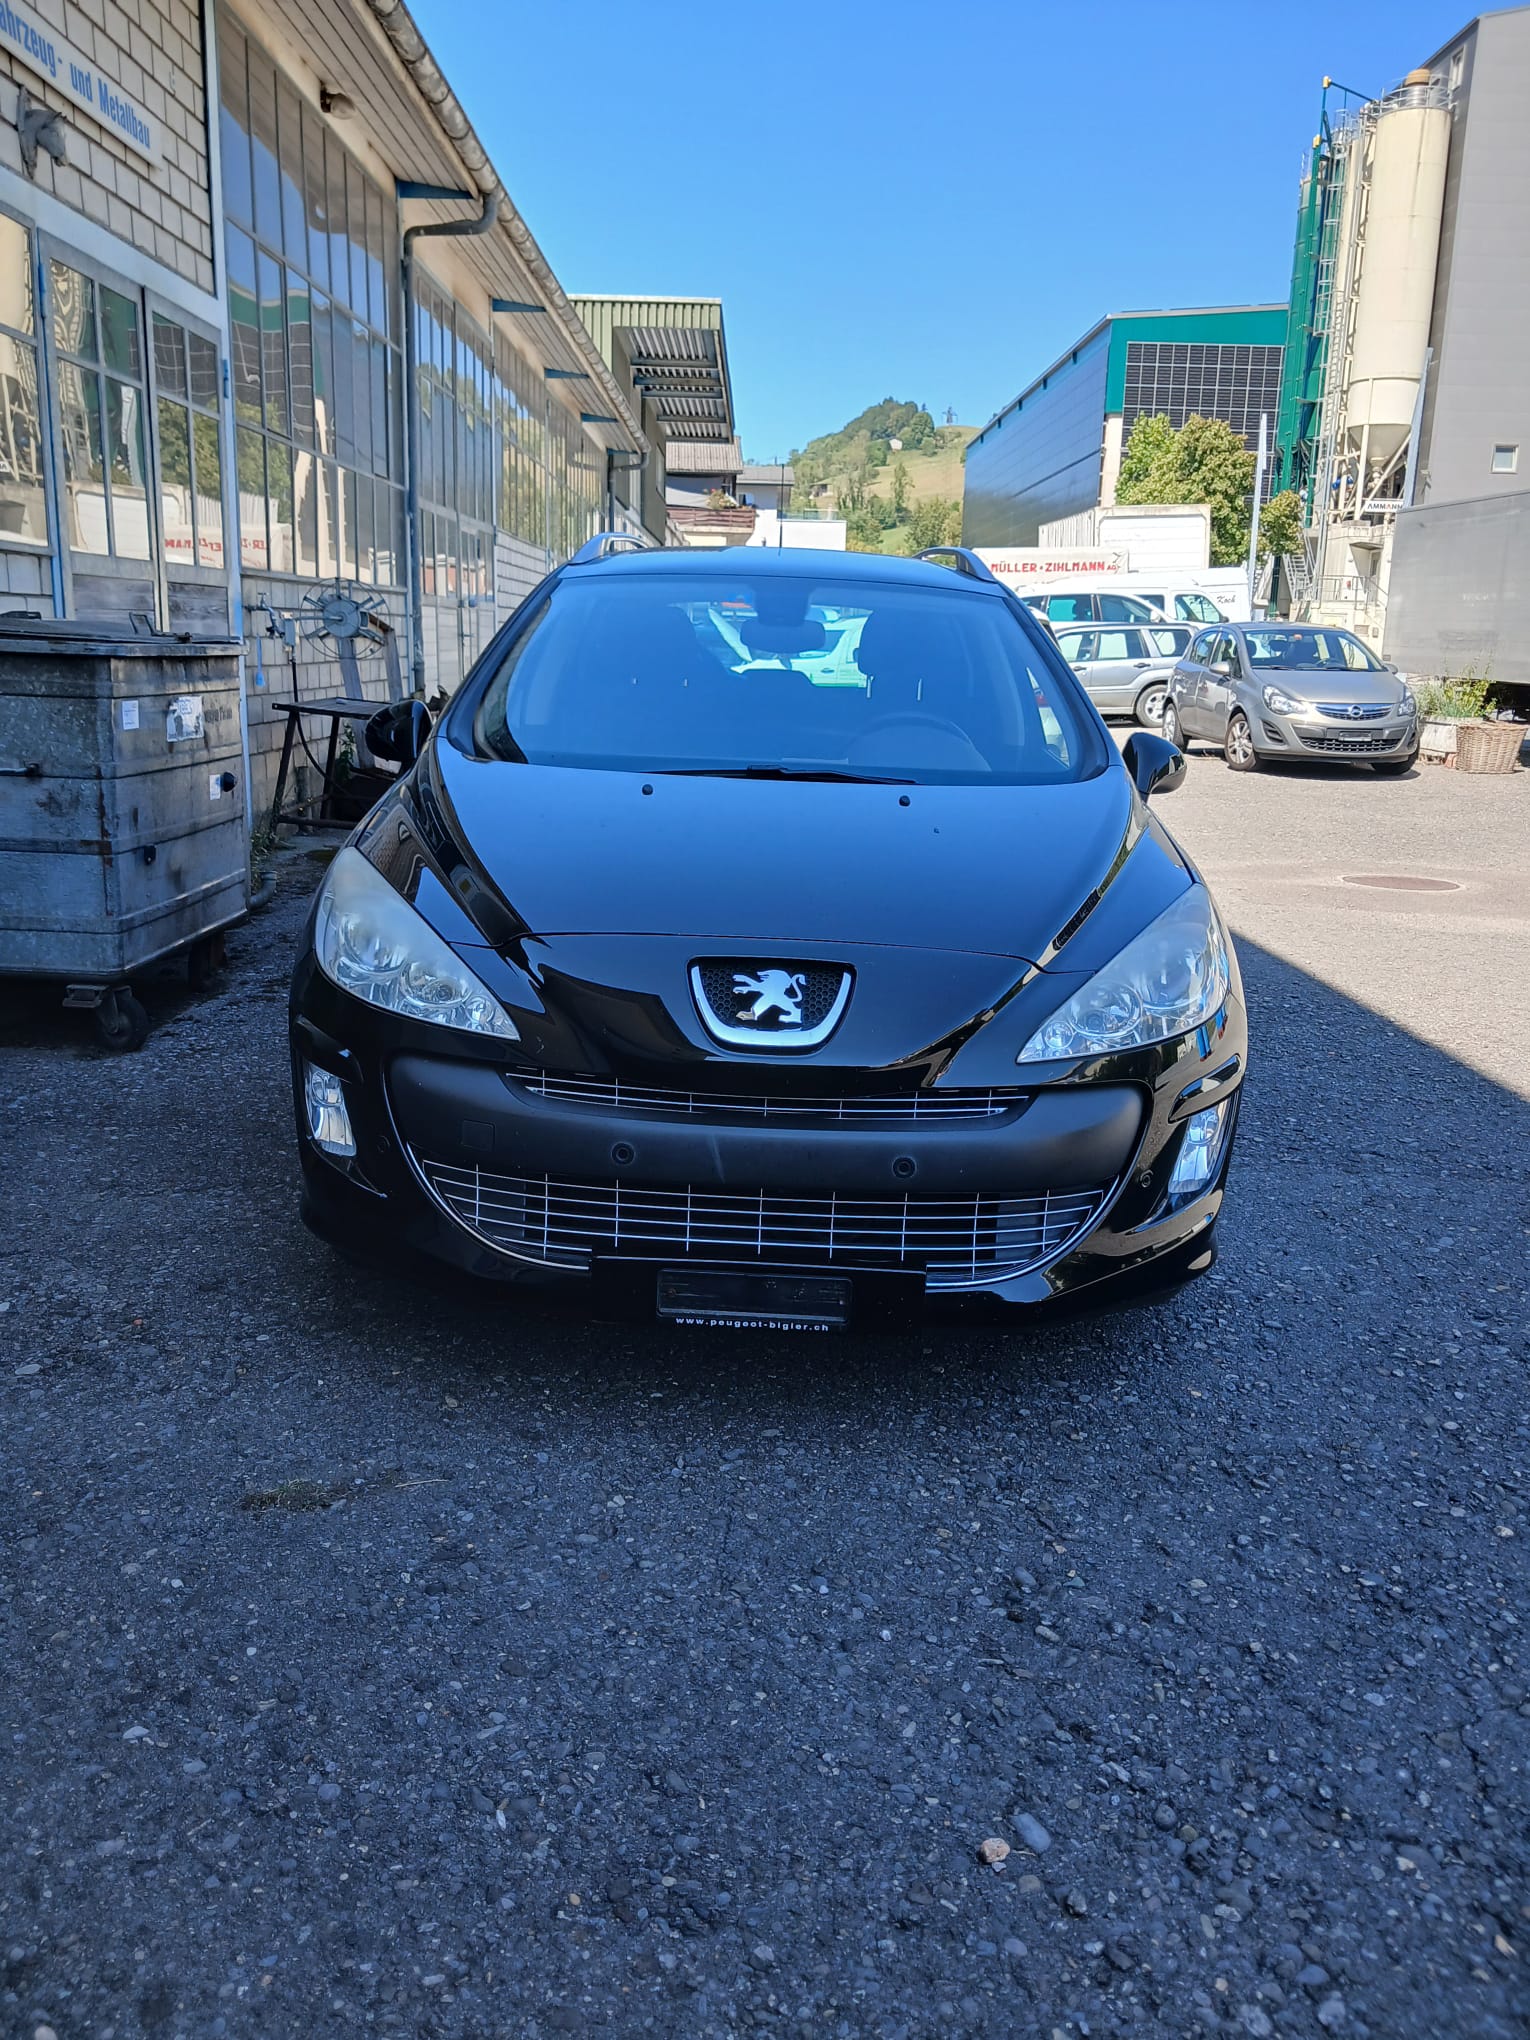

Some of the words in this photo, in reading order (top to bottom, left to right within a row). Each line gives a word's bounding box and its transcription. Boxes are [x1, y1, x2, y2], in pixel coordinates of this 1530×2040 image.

[0, 0, 63, 78] ahrzeug-
[70, 62, 93, 102] und
[97, 77, 151, 149] Metallbau
[991, 560, 1037, 573] MÜLLER
[1045, 561, 1105, 573] ZIHLMANN
[675, 1317, 829, 1332] www.peugeot-bigler.ch
